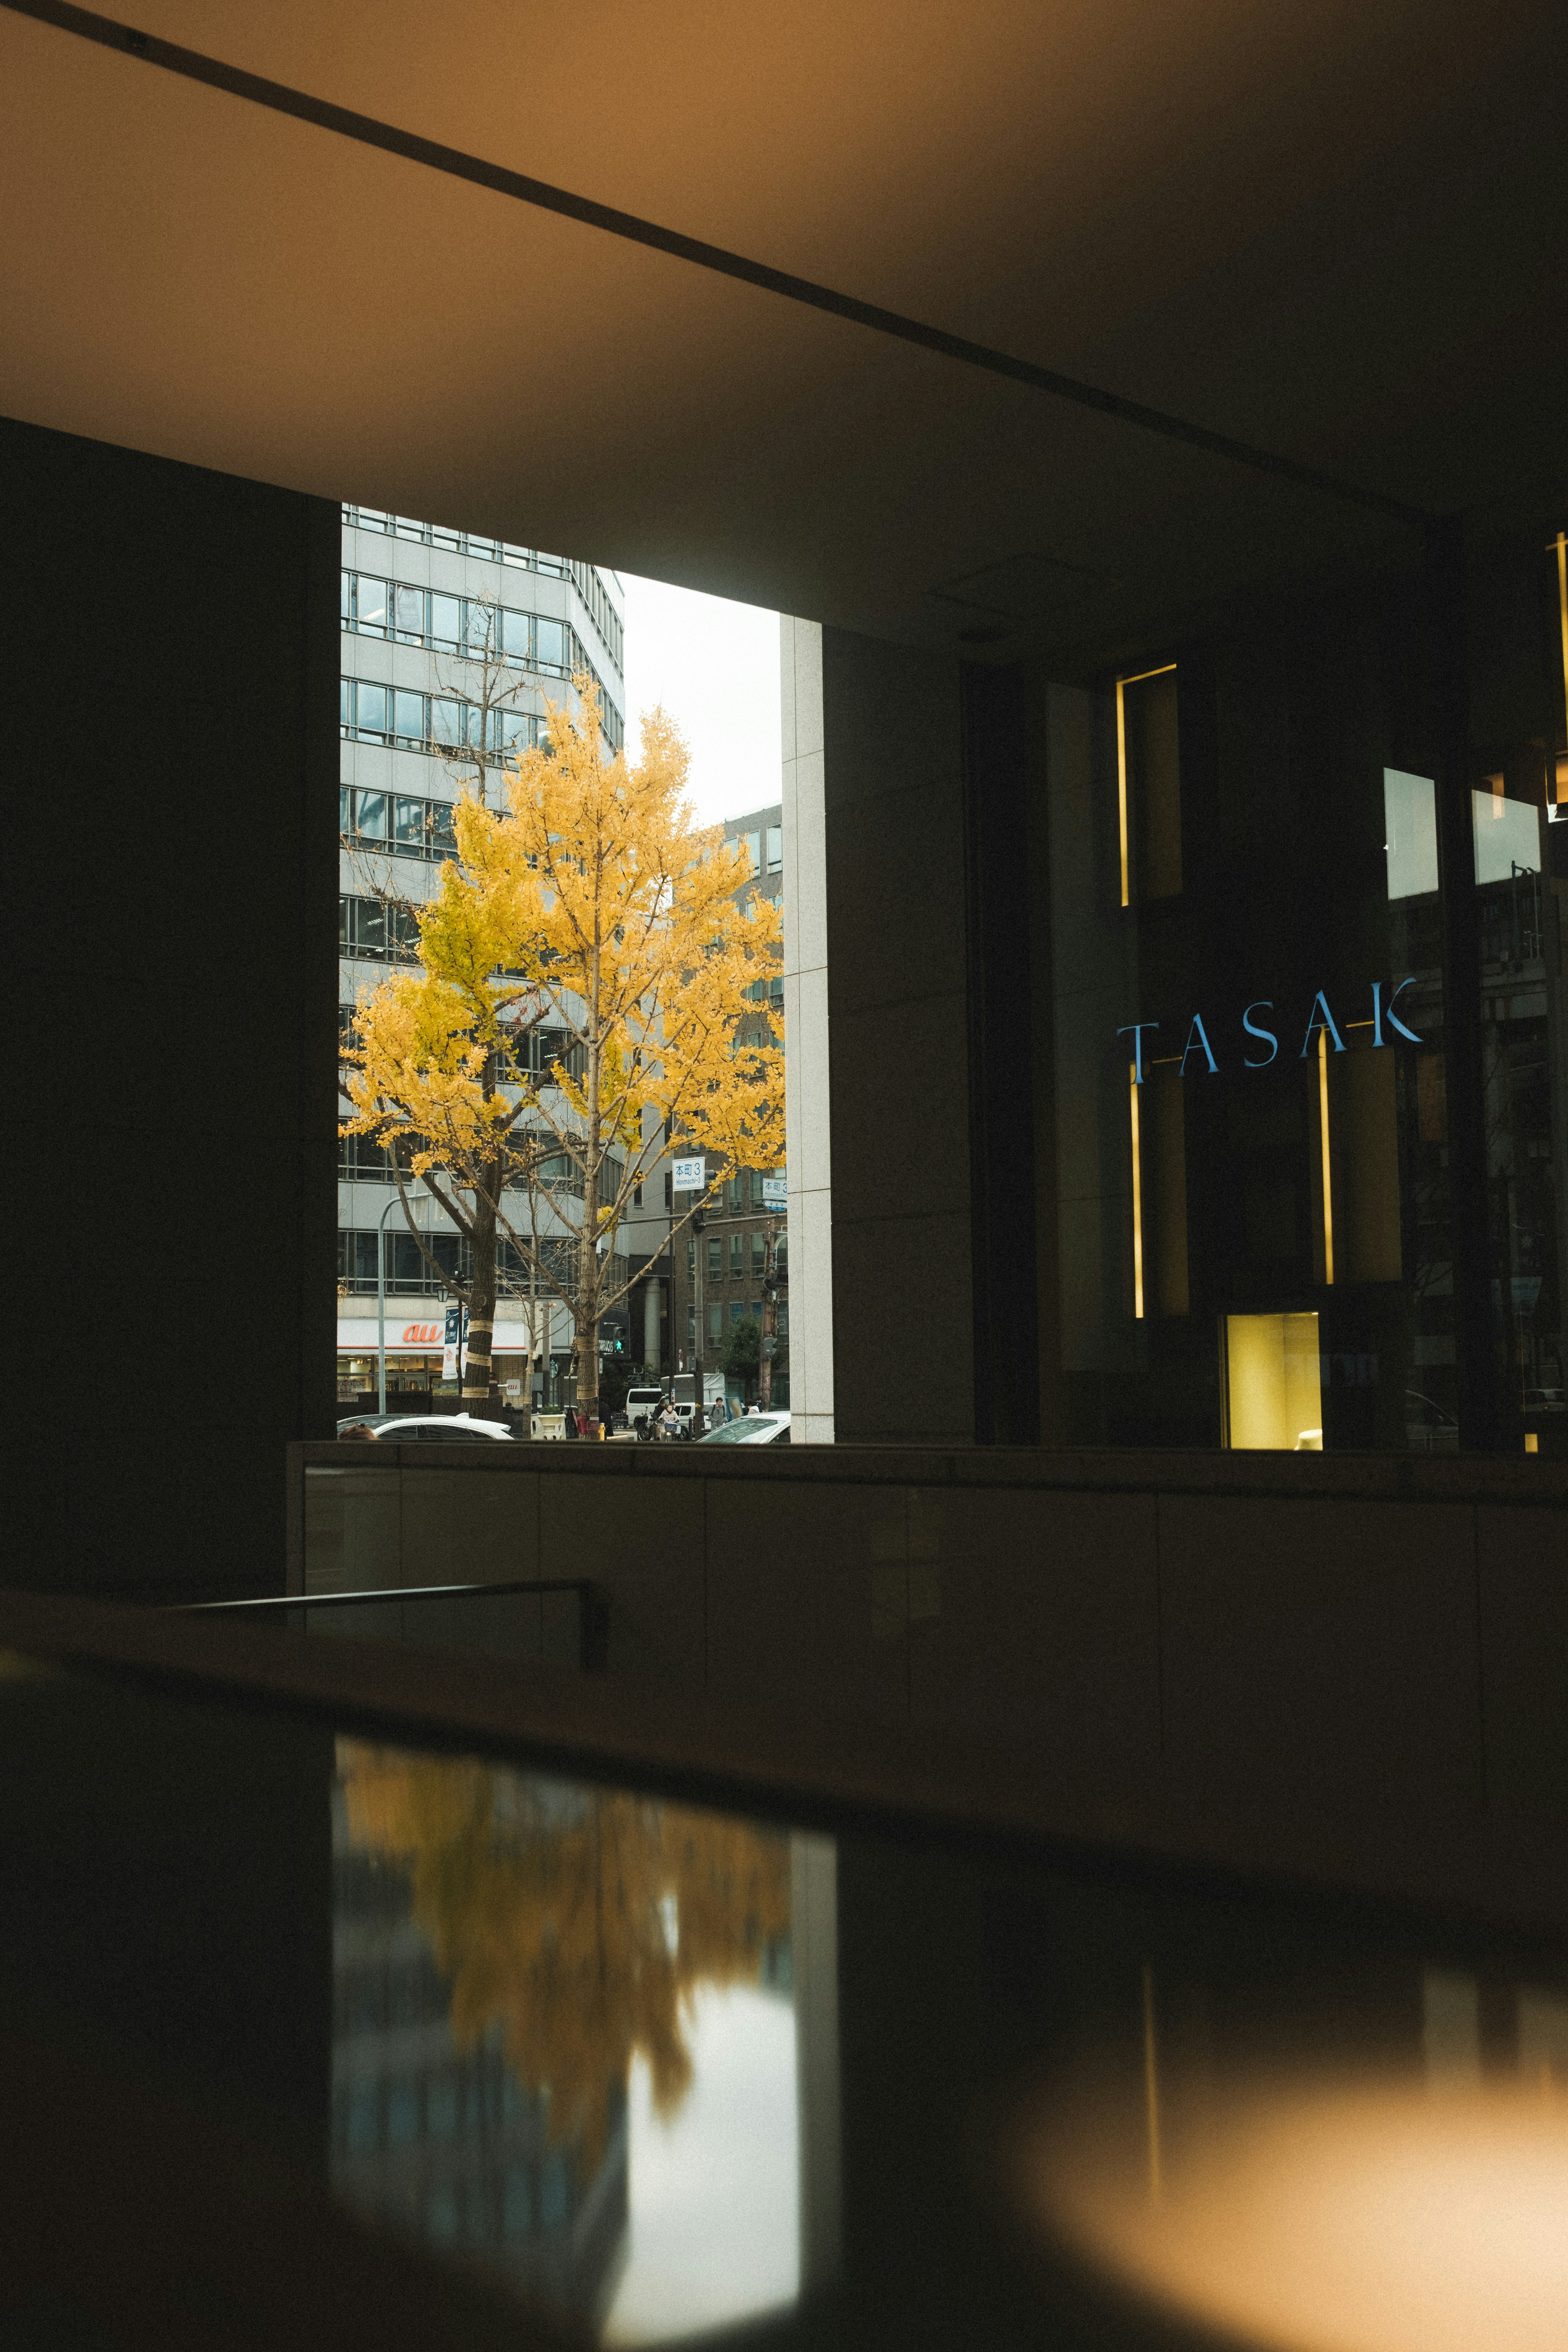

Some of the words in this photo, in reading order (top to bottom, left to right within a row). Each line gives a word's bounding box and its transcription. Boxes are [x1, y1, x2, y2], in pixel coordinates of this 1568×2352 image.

[1116, 977, 1424, 1085] TASAK
[676, 1177, 701, 1185] Honmachi-3
[403, 1325, 443, 1342] au
[597, 1340, 613, 1352] TARBUCKS
